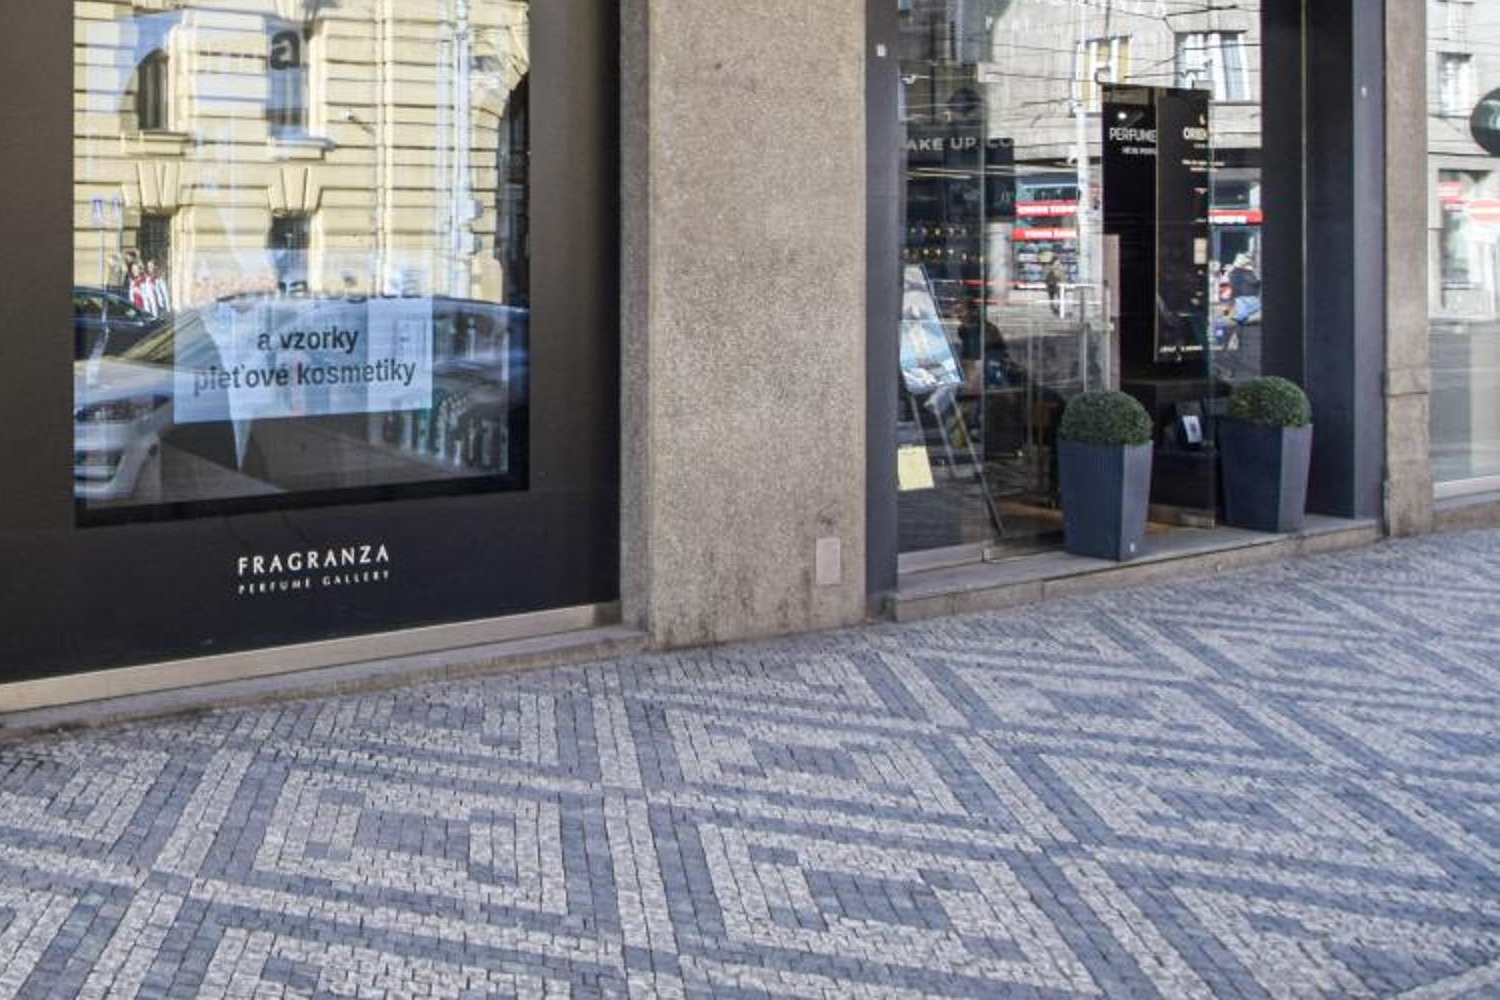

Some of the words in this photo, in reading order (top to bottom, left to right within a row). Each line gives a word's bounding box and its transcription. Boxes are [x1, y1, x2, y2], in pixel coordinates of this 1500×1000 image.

[903, 136, 944, 152] AKE
[256, 333, 271, 350] a
[279, 325, 359, 354] vzorky
[296, 357, 418, 387] kosmetiky
[237, 543, 390, 576] FRAGRANZA
[237, 577, 311, 596] PERFUME
[322, 569, 390, 587] GALLERY
